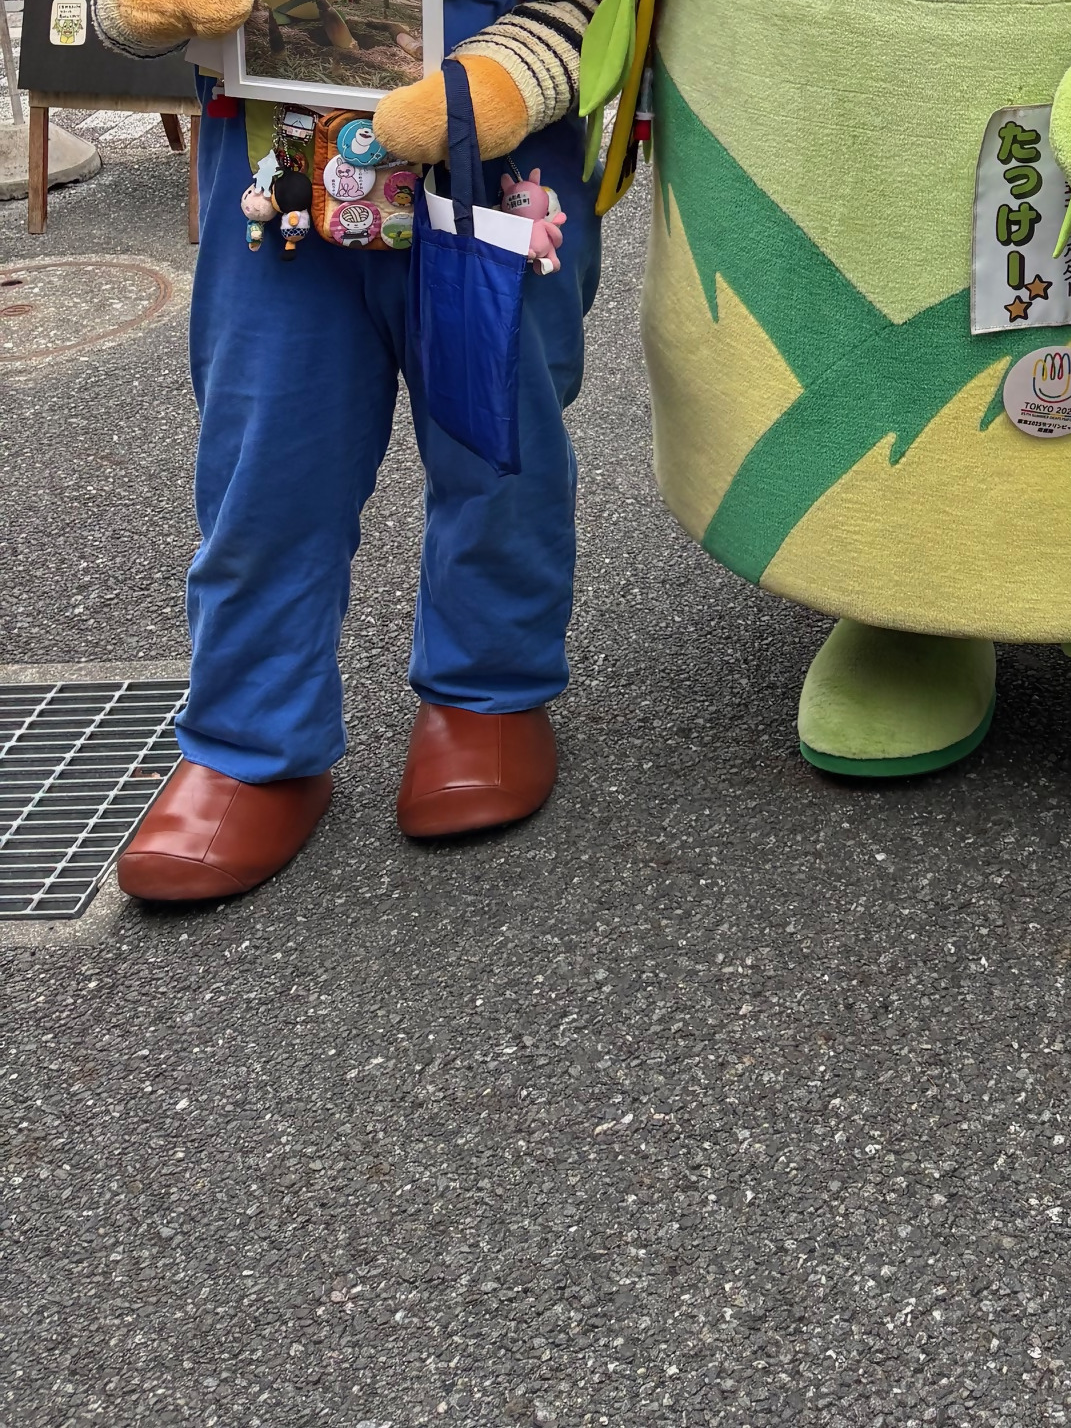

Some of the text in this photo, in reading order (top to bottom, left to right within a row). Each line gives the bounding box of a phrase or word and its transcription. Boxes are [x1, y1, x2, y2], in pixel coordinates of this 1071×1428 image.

[996, 121, 1042, 290] たっけー
[1024, 402, 1054, 413] TOKYO
